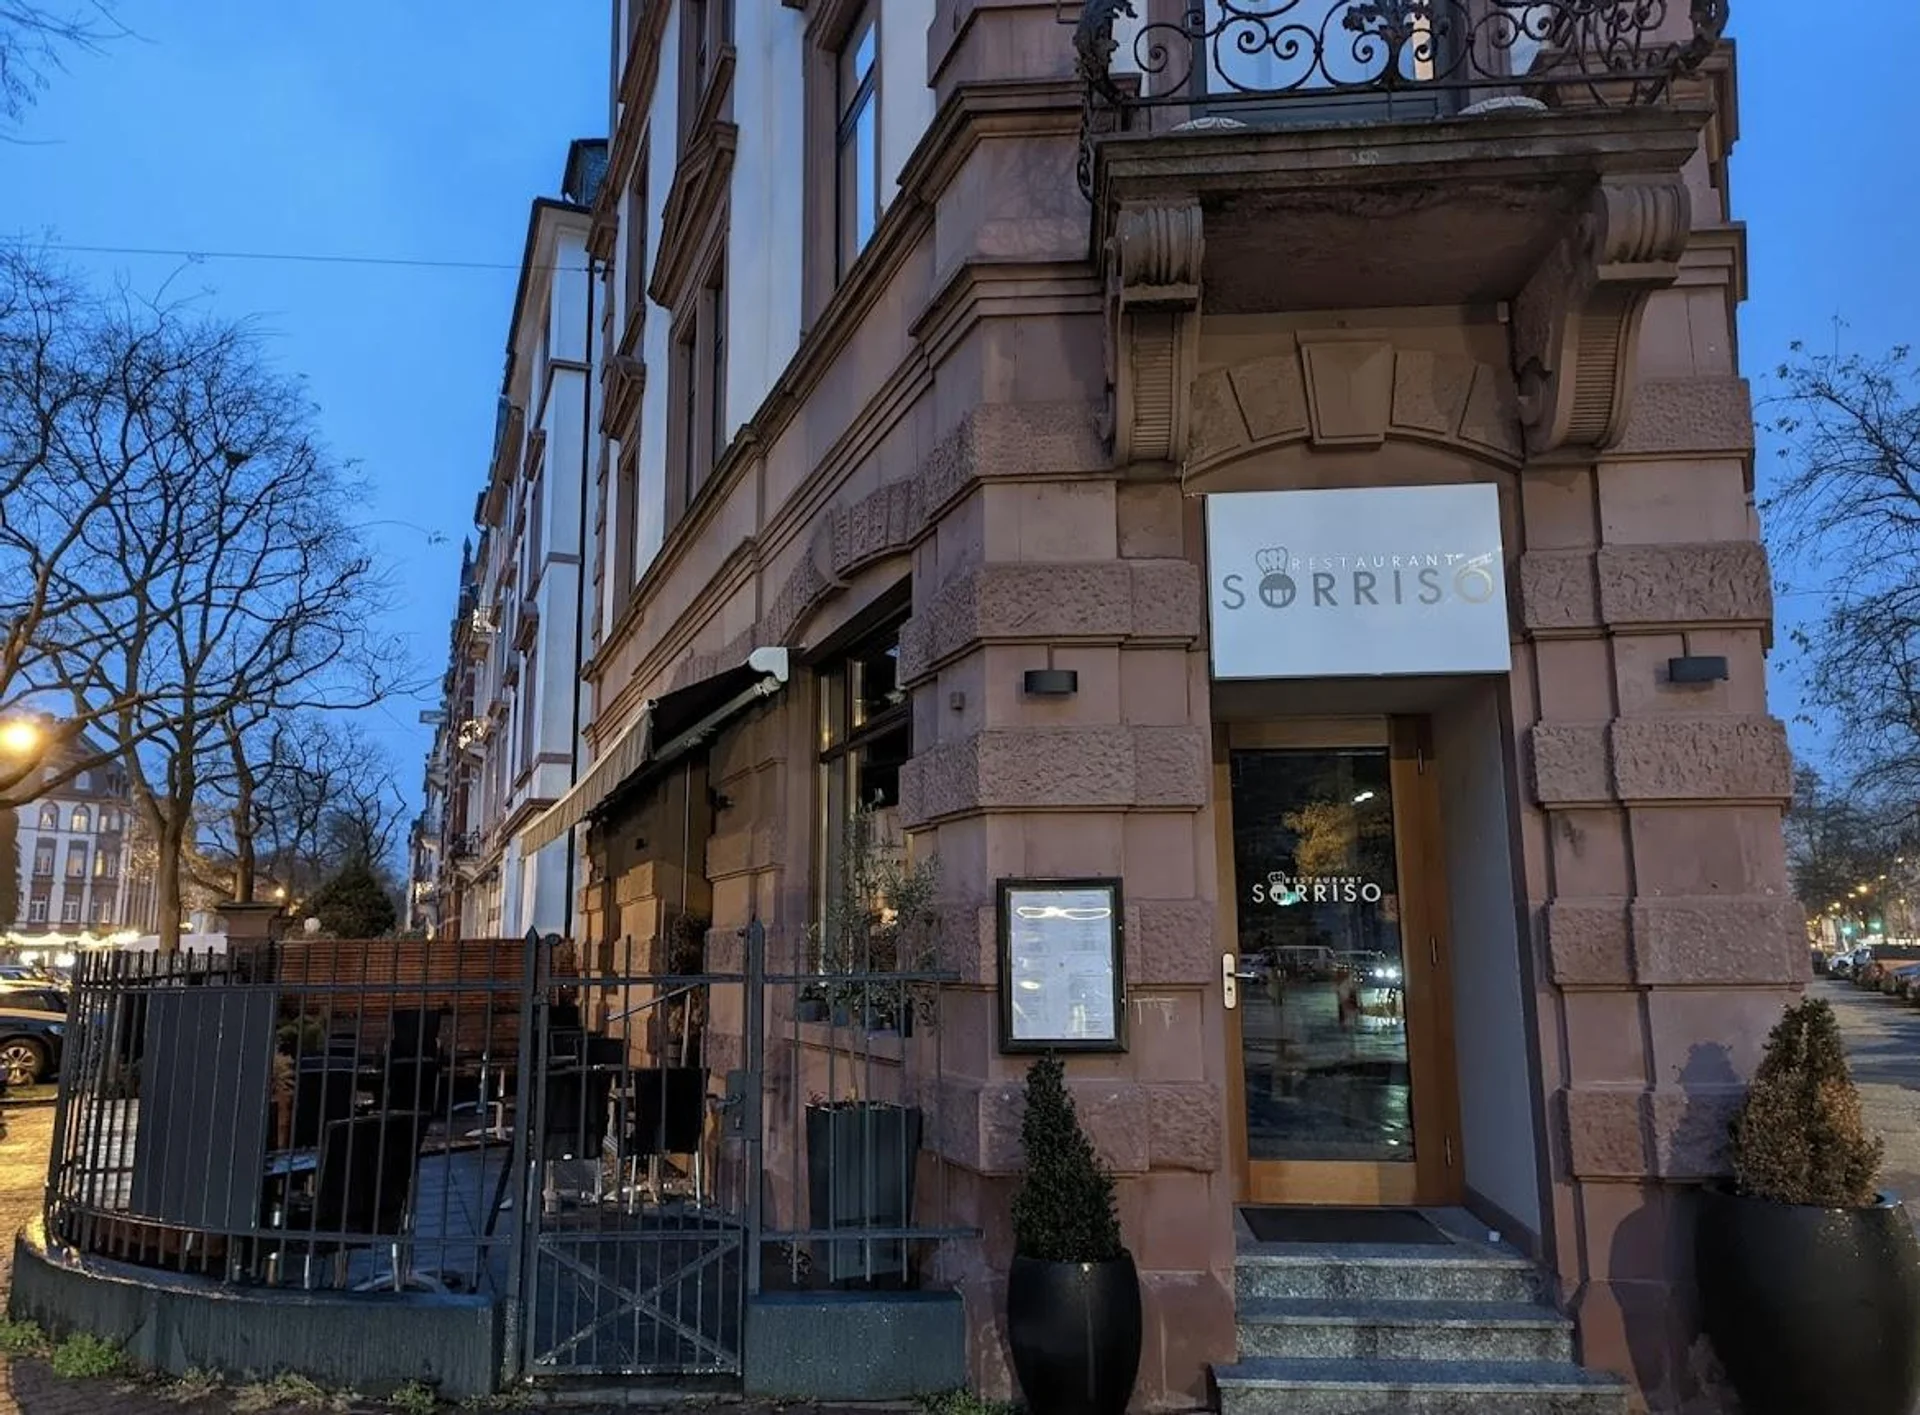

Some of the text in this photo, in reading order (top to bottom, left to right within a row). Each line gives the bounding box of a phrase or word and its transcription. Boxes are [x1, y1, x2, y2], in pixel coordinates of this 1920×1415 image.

[1289, 553, 1456, 571] RESTAURANT
[1221, 567, 1494, 610] SORRISO
[1285, 875, 1362, 884] RESTAURANT
[1251, 882, 1382, 903] SORRISO
